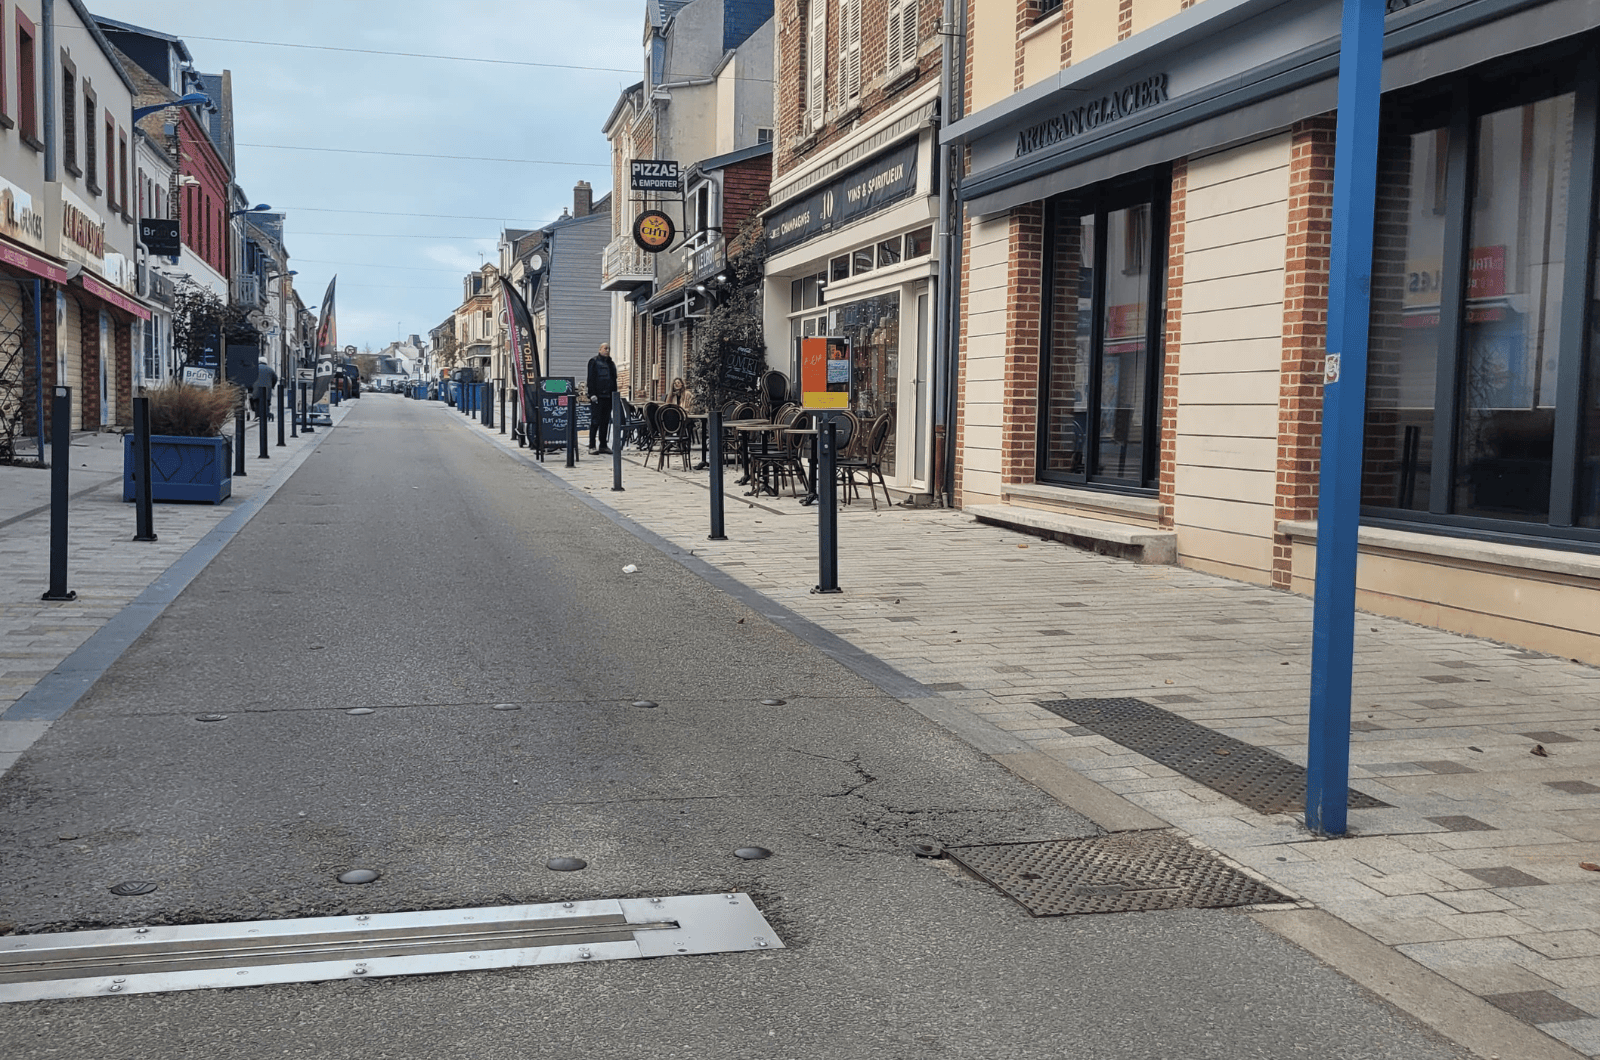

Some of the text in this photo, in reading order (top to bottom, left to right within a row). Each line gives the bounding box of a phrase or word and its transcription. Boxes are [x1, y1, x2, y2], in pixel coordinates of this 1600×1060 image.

[1014, 72, 1169, 159] ARTISAN GLACIER
[632, 162, 677, 177] PIZZAS
[631, 177, 677, 188] À EMPORTER
[847, 163, 904, 203] VINS & SPIRITUEUX
[823, 190, 834, 220] 10
[781, 211, 810, 235] CHAMPAGNES
[143, 226, 178, 238] Bro
[186, 370, 213, 379] Bruno
[543, 399, 557, 407] PLAT
